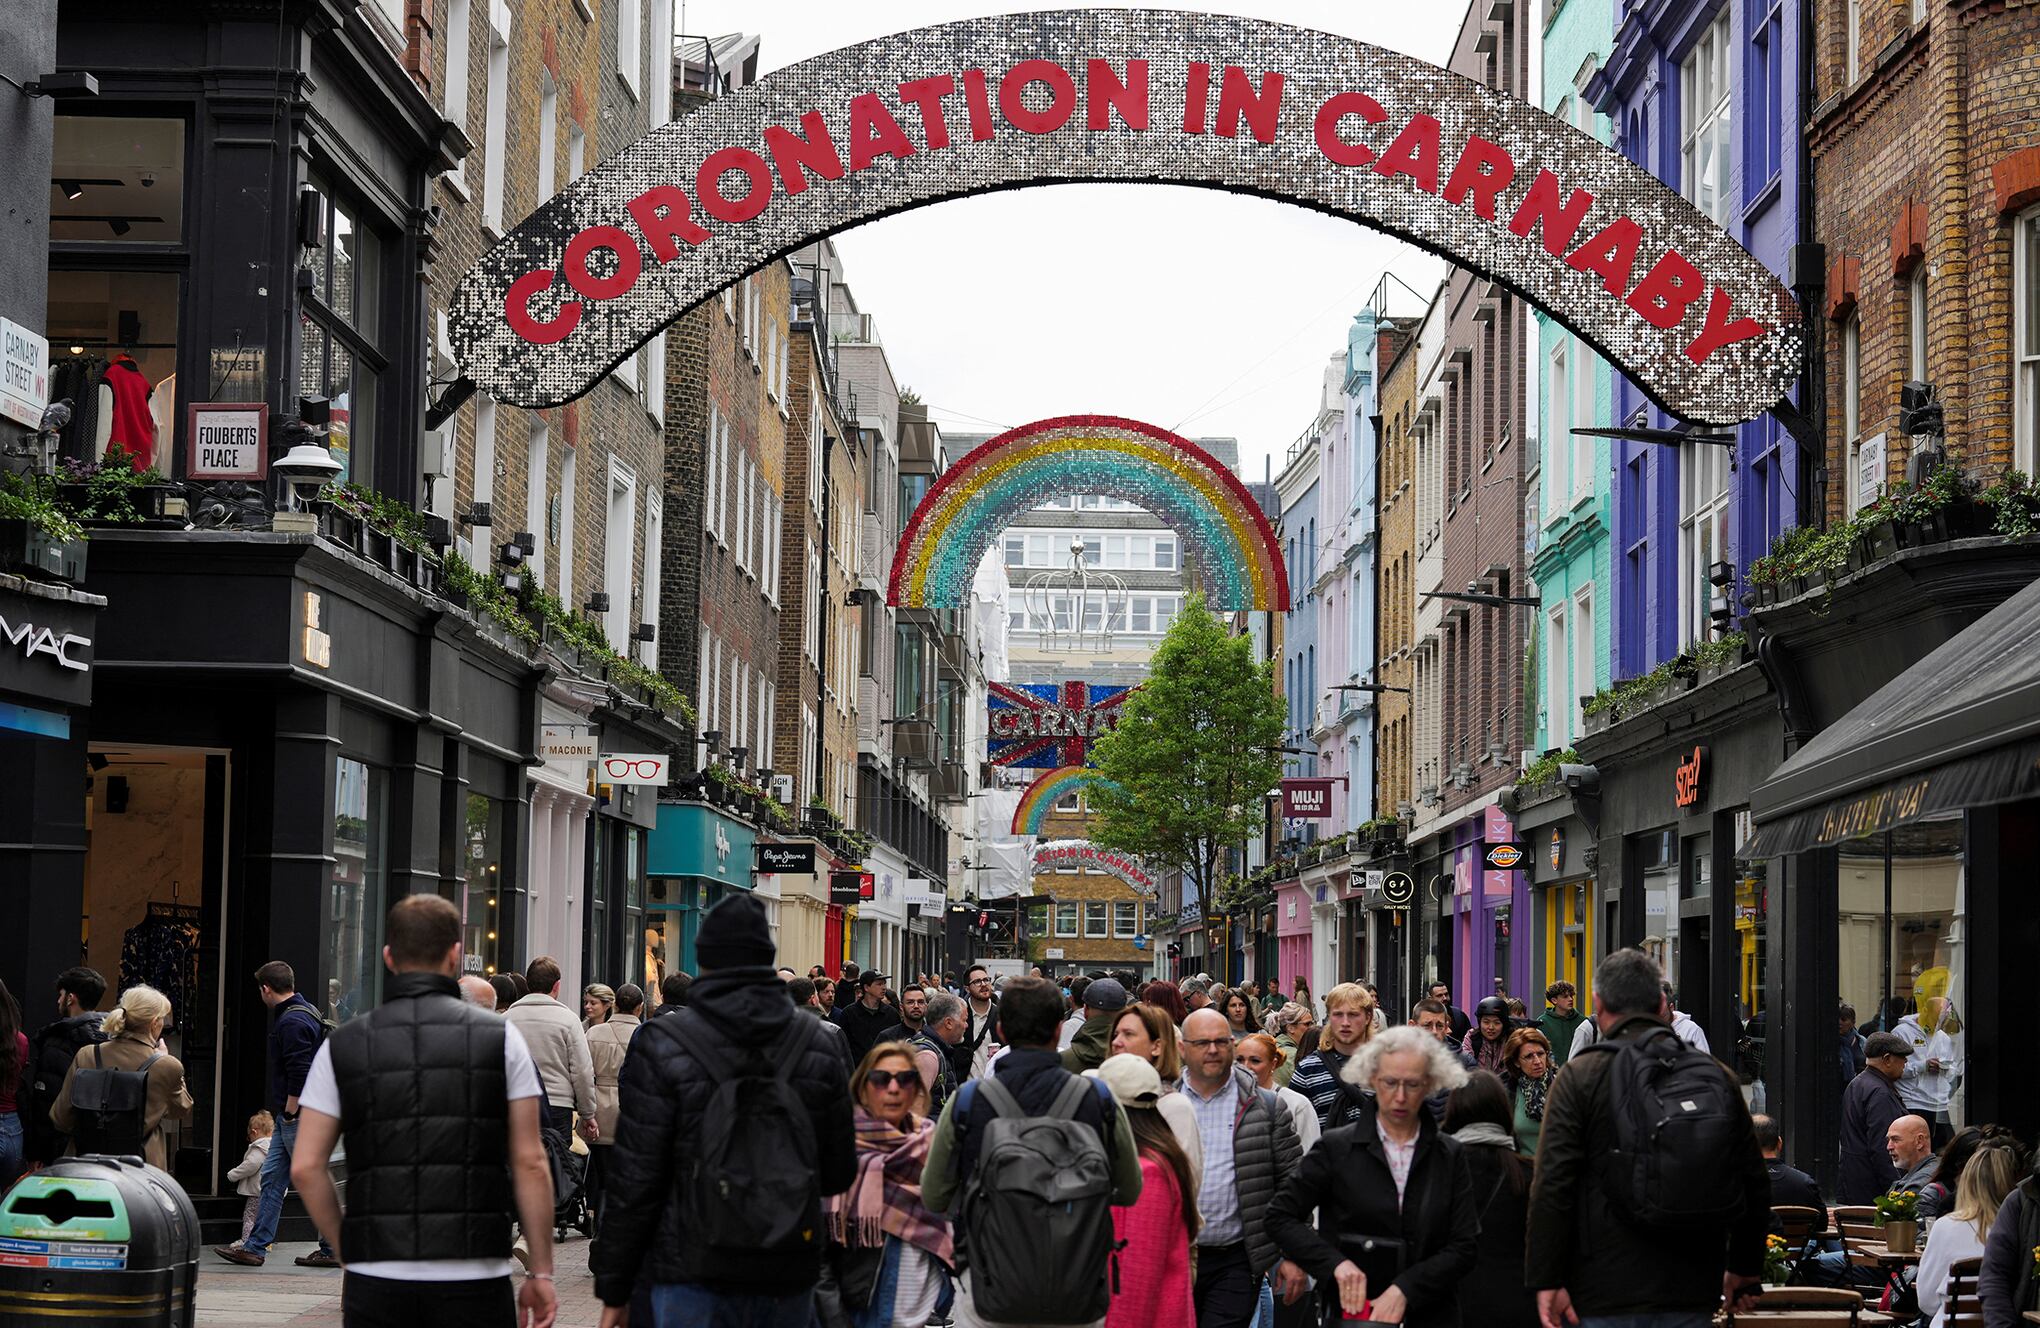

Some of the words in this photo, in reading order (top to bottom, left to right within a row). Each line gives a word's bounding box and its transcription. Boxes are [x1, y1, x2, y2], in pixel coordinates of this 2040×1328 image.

[505, 58, 1148, 345] CORONATION
[1183, 61, 1284, 145] IN
[1313, 91, 1765, 366] CARNABY
[5, 331, 39, 368] CARNABY
[6, 360, 32, 393] STREET
[199, 425, 257, 446] FOUBERT'S
[202, 449, 239, 468] PLACE
[549, 745, 592, 755] MACONIE
[1676, 746, 1701, 809] size?
[1291, 790, 1324, 804] MUJI
[763, 849, 782, 863] Pepe
[782, 850, 807, 864] Jeans
[1490, 851, 1519, 860] Dickies
[1080, 848, 1094, 858] IN
[1097, 851, 1153, 886] CARNABY
